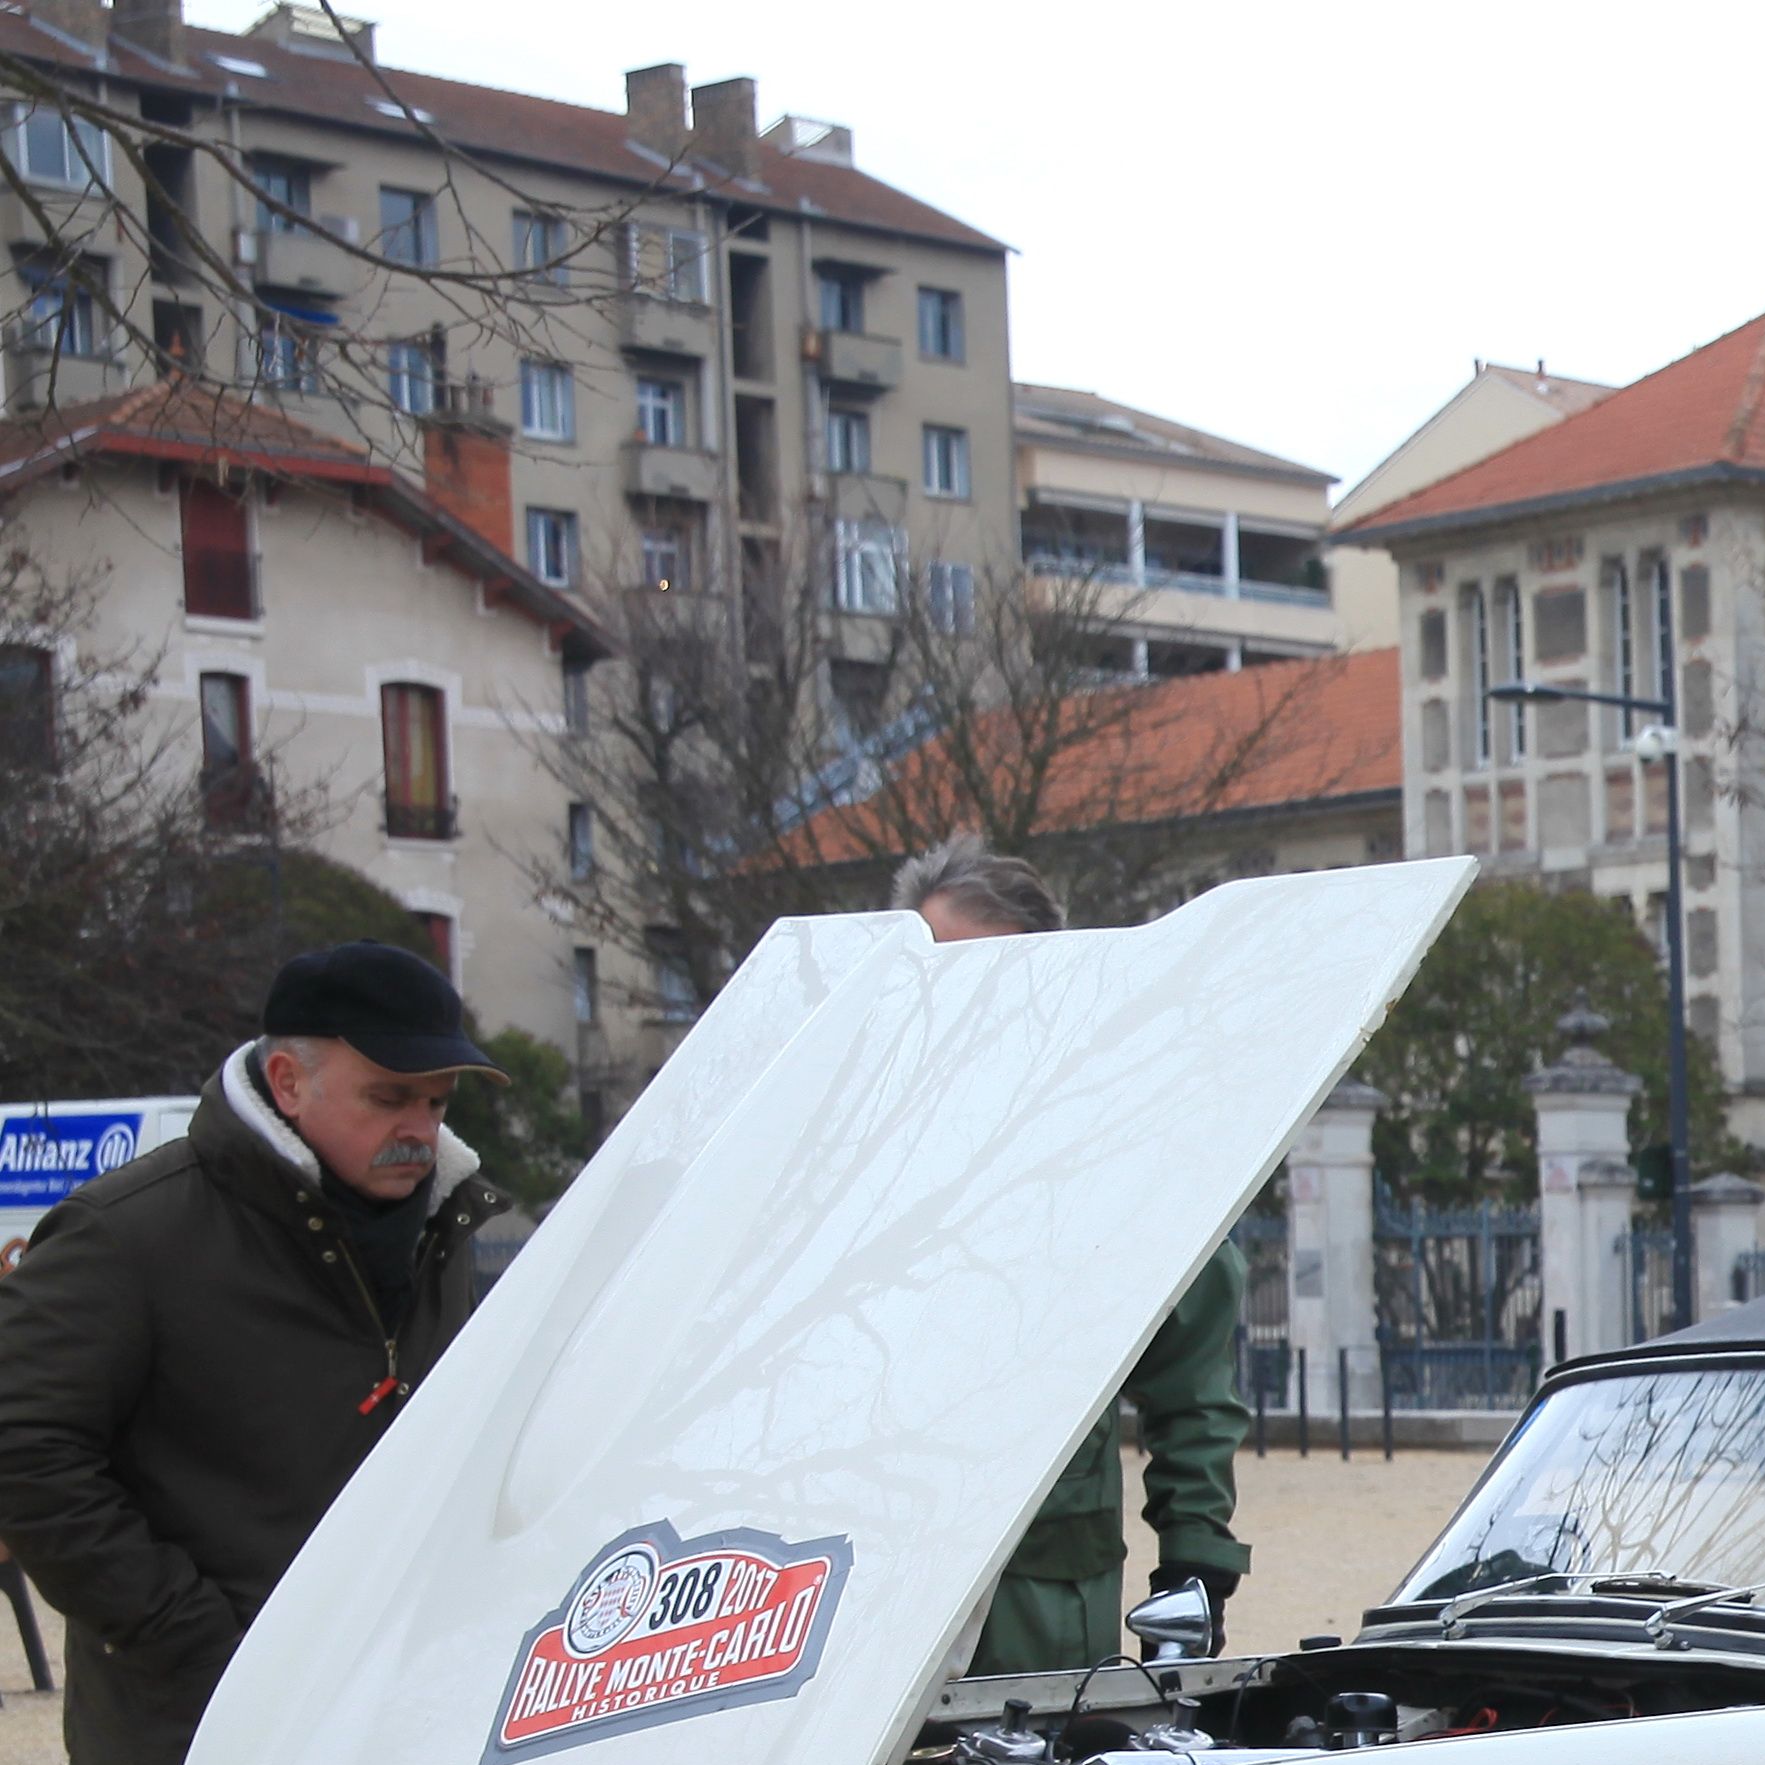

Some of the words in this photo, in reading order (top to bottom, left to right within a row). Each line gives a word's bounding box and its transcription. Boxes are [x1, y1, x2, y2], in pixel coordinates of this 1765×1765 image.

[0, 1132, 94, 1172] Allianz
[649, 1562, 723, 1631] 308
[715, 1559, 779, 1621] 2017
[512, 1655, 607, 1723] RALLYE
[603, 1585, 816, 1697] MONTE-CARLO
[570, 1671, 722, 1722] HISTORIQUE
